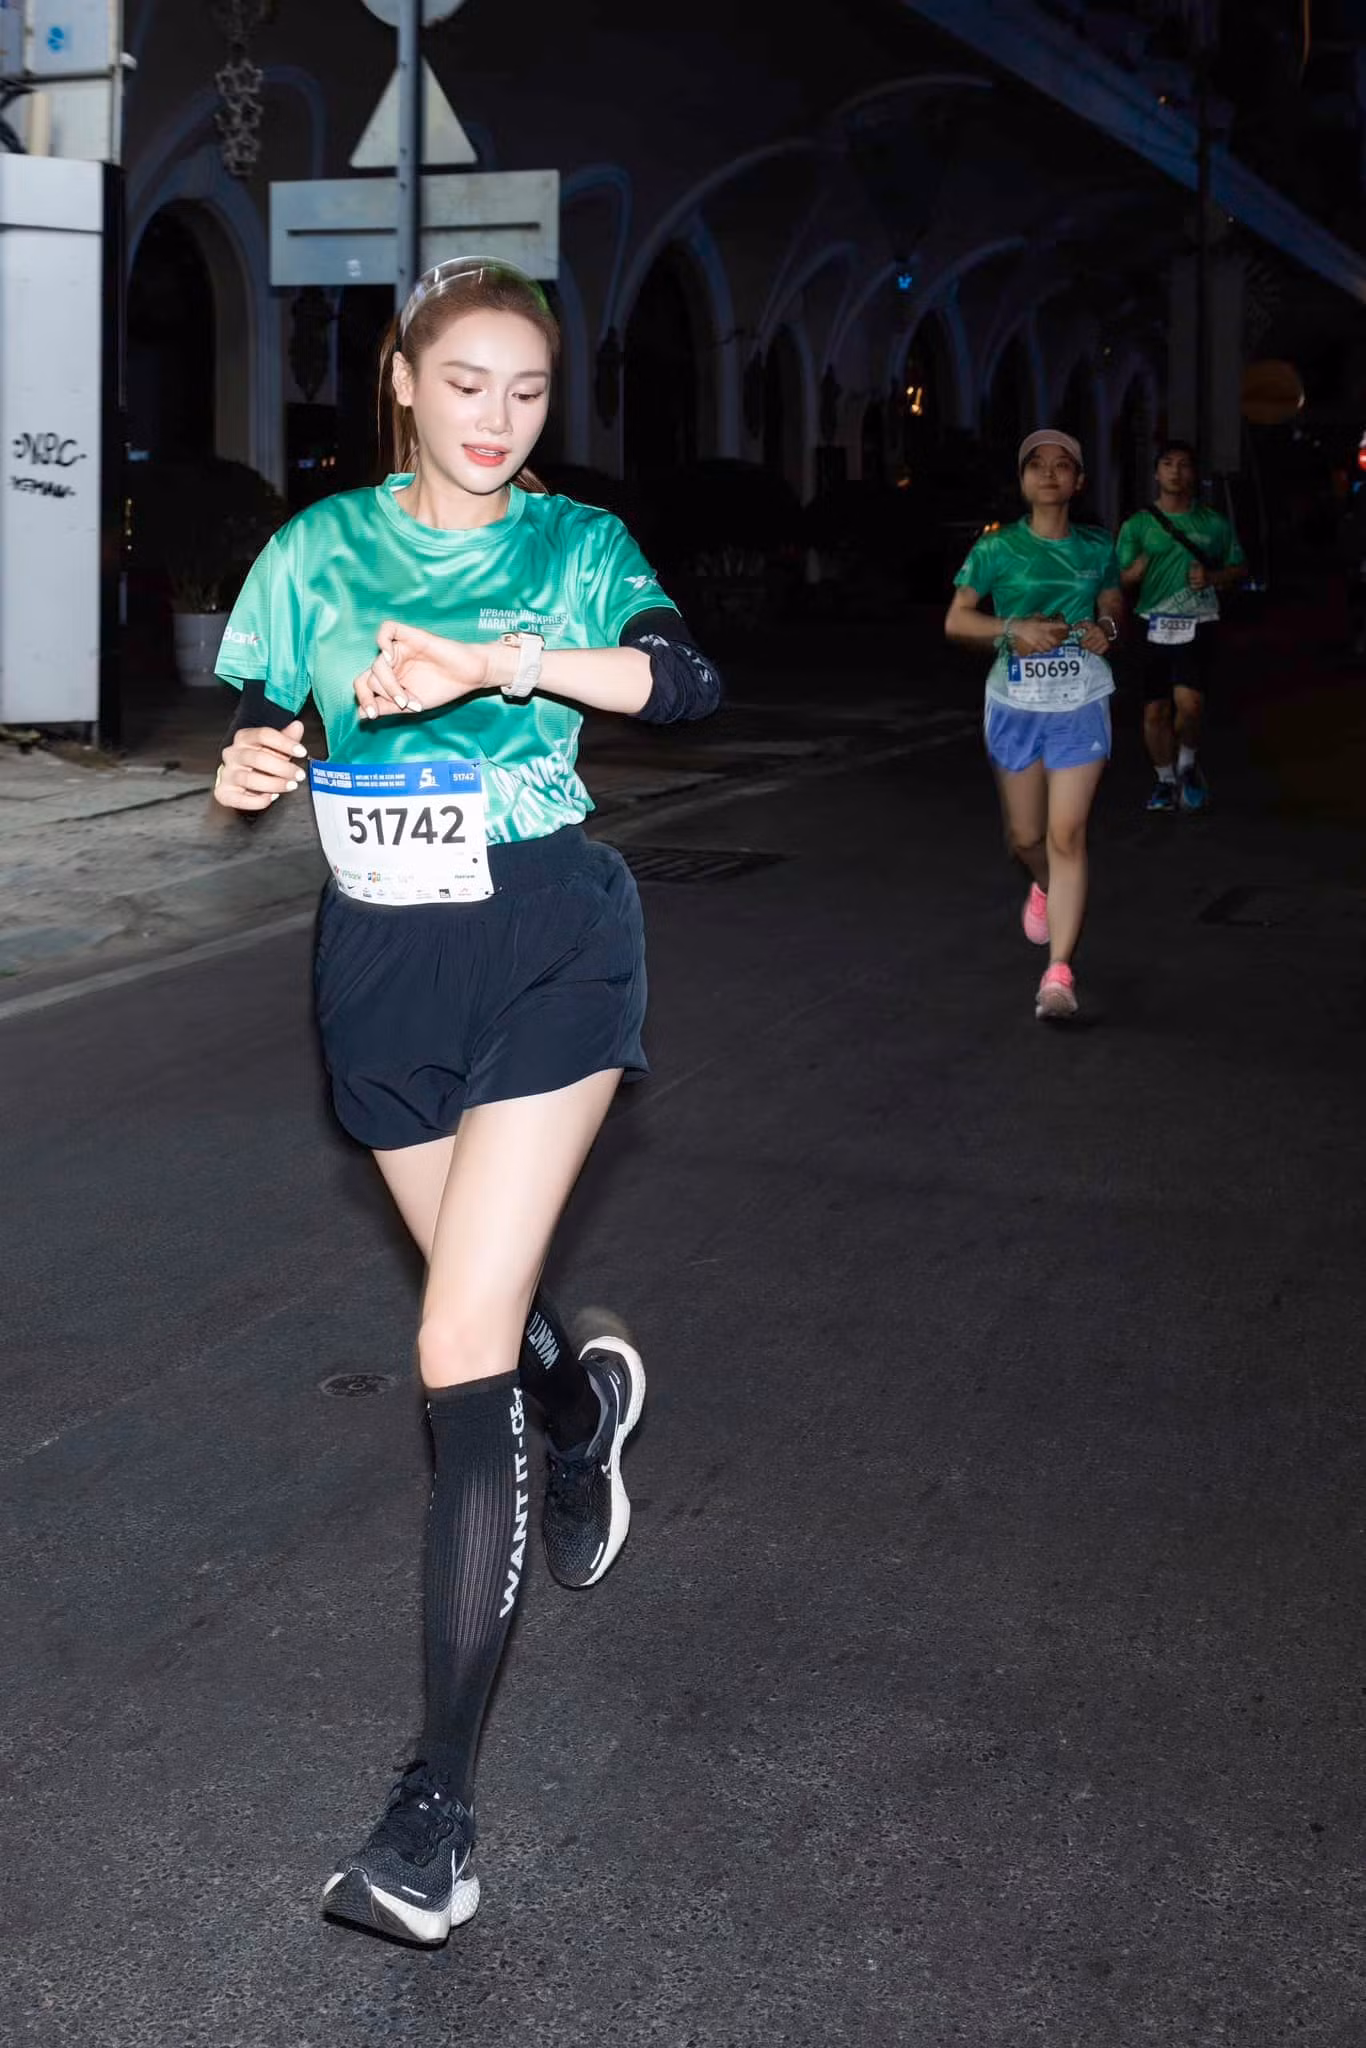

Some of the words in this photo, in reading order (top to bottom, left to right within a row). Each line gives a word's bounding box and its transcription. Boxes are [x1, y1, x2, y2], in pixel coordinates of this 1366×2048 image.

[480, 608, 517, 618] VPBANK
[1159, 619, 1193, 630] 50337
[1024, 660, 1080, 678] 50699
[347, 805, 466, 846] 51742
[499, 1490, 528, 1618] WANT
[514, 1453, 528, 1483] IT
